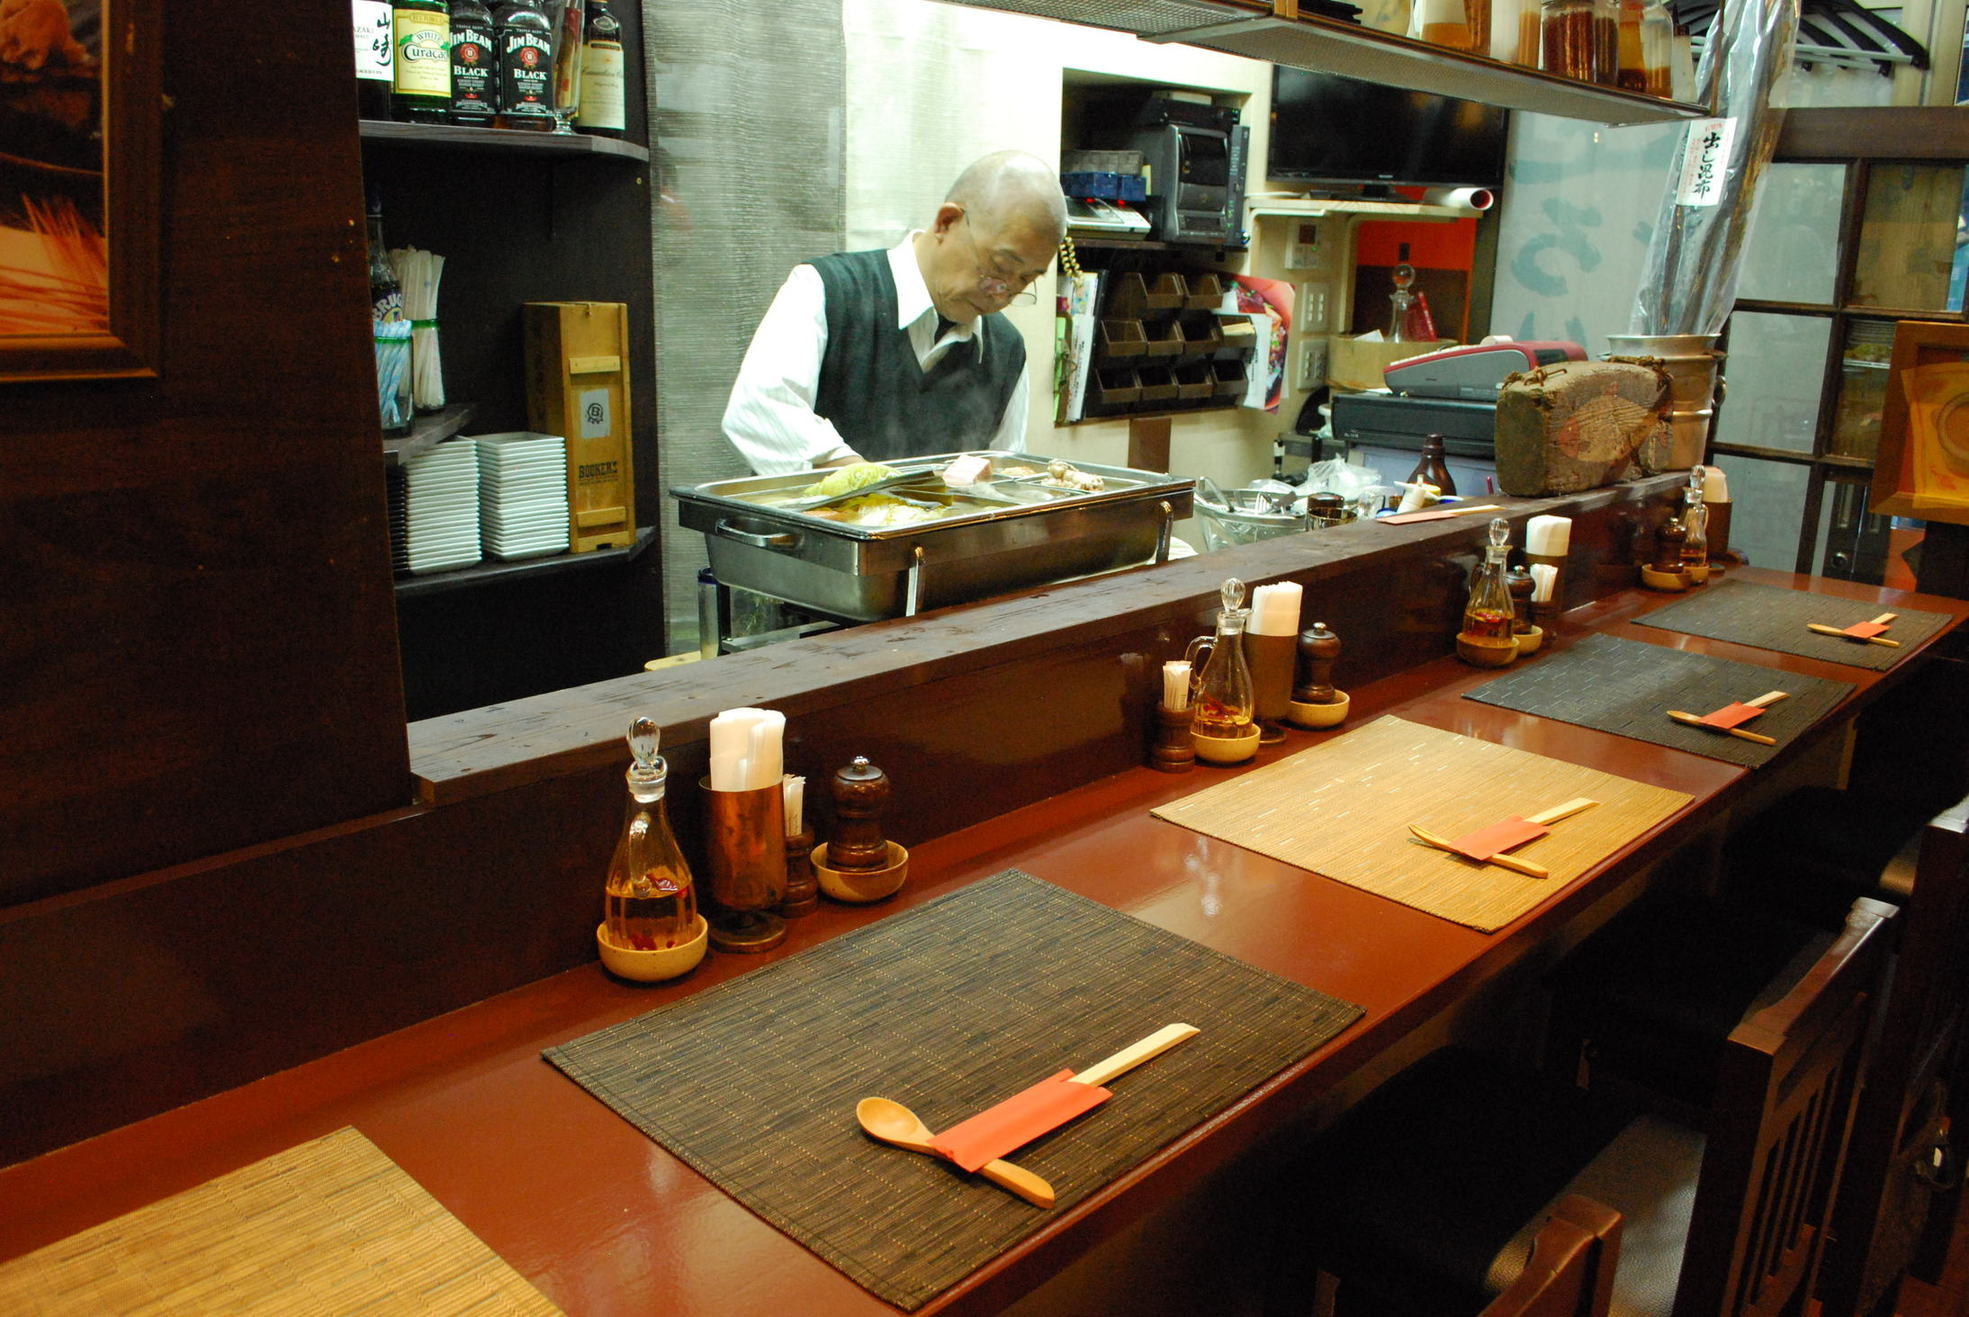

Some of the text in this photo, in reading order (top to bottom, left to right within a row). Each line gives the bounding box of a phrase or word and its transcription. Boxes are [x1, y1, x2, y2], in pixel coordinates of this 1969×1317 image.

[449, 29, 493, 53] JIM BEAM
[506, 33, 551, 56] JIM BEAM
[453, 64, 489, 78] BLACK
[513, 68, 548, 81] BLACK
[1693, 131, 1721, 200] 出し昆布
